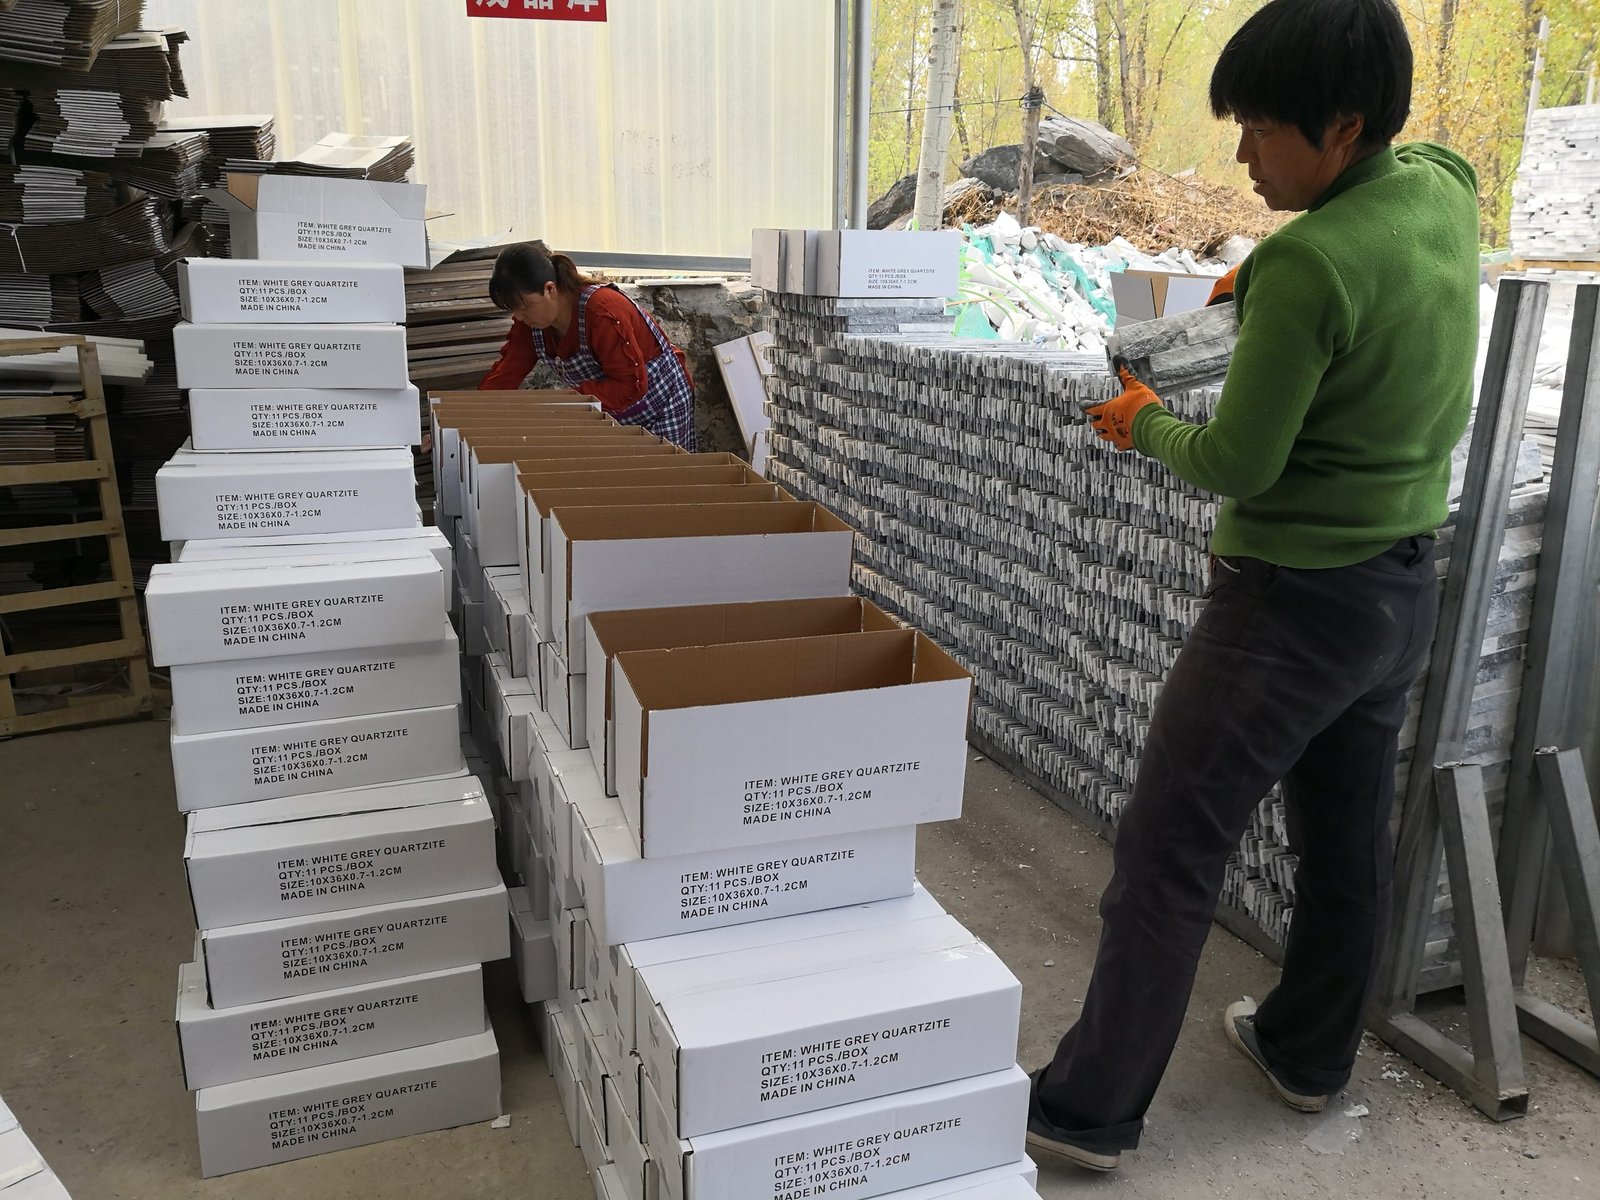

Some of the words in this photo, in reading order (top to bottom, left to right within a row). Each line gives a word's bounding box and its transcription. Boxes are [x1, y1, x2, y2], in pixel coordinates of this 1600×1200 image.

[306, 490, 358, 498] QUARTZITE
[252, 502, 297, 510] PCS./BOX
[221, 606, 250, 614] ITEM:
[253, 602, 288, 611] WHITE
[292, 600, 320, 608] GREY
[324, 594, 384, 606] QUARTZITE
[222, 615, 258, 625] QTY:11
[262, 610, 314, 621] PCS./BOX
[223, 618, 341, 635] SIZE:10X36X0.7-1.2CM
[224, 636, 255, 646] MADE
[272, 632, 306, 641] CHINA
[236, 675, 265, 684] ITEM:
[268, 671, 302, 681] WHITE
[305, 668, 334, 677] GREY
[337, 662, 395, 674] QUARTZITE
[238, 686, 354, 704] SIZE:10X36X0.7-1.2CM
[252, 746, 280, 755] ITEM:
[283, 740, 316, 750] WHITE
[320, 736, 348, 746] GREY
[351, 729, 408, 742] QUARTZITE
[253, 754, 287, 765] QTY:11
[292, 747, 341, 760] PCS./BOX
[254, 753, 367, 775] SIZE:10X36X0.7-1.2CM
[254, 774, 285, 784] MADE
[288, 772, 298, 780] IN
[301, 768, 333, 778] CHINA
[745, 779, 776, 790] ITEM:
[781, 774, 818, 785] WHITE
[822, 770, 853, 780] GREY
[856, 762, 920, 776] QUARTZITE
[744, 790, 783, 801] QTY:11
[788, 782, 843, 796] PCS./BOX
[744, 790, 871, 813] SIZE:10X36X0.7-1.2CM
[744, 813, 776, 825] MADE
[781, 812, 791, 820] IN
[795, 807, 831, 818] CHINA
[278, 859, 308, 869] ITEM:
[312, 853, 348, 864] WHITE
[351, 849, 380, 859] GREY
[384, 840, 445, 855] QUARTZITE
[279, 868, 316, 880] QTY:11
[320, 860, 373, 874] PCS./BOX
[280, 866, 401, 890] SIZE:10X36X0.7-1.2CM
[681, 872, 712, 883] ITEM:
[716, 865, 753, 878] WHITE
[757, 860, 788, 871] GREY
[792, 850, 854, 866] QUARTZITE
[281, 889, 313, 900] MADE
[316, 887, 327, 895] IN
[330, 882, 365, 893] CHINA
[681, 882, 719, 895] QTY:11
[724, 873, 778, 888] PCS./BOX
[681, 880, 807, 907] SIZE:10X36X0.7-1.2CM
[681, 906, 714, 919] MADE
[718, 904, 728, 913] IN
[733, 898, 768, 910] CHINA
[251, 1020, 281, 1031] ITEM:
[284, 1012, 320, 1024] WHITE
[324, 1006, 354, 1017] GREY
[357, 995, 418, 1011] QUARTZITE
[252, 1028, 288, 1040] QTY:11
[293, 1017, 346, 1033] PCS./BOX
[252, 1022, 374, 1050] SIZE:10X36X0.7-1.2CM
[254, 1048, 286, 1060] MADE
[289, 1046, 299, 1054] IN
[303, 1039, 338, 1051] CHINA
[762, 1049, 796, 1064] ITEM:
[801, 1040, 840, 1055] WHITE
[845, 1032, 878, 1046] GREY
[882, 1019, 950, 1039] QUARTZITE
[761, 1053, 898, 1089] SIZE:10X36X0.7-1.2CM
[762, 1060, 803, 1076] QTY:11
[809, 1046, 868, 1066] PCS./BOX
[761, 1086, 797, 1102] MADE
[801, 1082, 812, 1092] IN
[817, 1074, 855, 1088] CHINA
[269, 1108, 300, 1120] ITEM:
[303, 1100, 339, 1113] WHITE
[342, 1093, 372, 1105] GREY
[376, 1080, 437, 1098] QUARTZITE
[270, 1116, 307, 1129] QTY:11
[312, 1104, 364, 1121] PCS./BOX
[271, 1109, 393, 1139] SIZE:10X36X0.7-1.2CM
[272, 1136, 304, 1149] MADE
[308, 1134, 318, 1142] IN
[322, 1126, 356, 1138] CHINA
[775, 1152, 808, 1166] ITEM:
[813, 1141, 852, 1158] WHITE
[857, 1133, 890, 1147] GREY
[894, 1118, 961, 1139] QUARTZITE
[774, 1153, 910, 1191] SIZE:10X36X0.7-1.2CM
[775, 1162, 816, 1178] QTY:11
[822, 1147, 880, 1168] PCS./BOX
[814, 1184, 825, 1194] IN
[830, 1175, 868, 1190] CHINA
